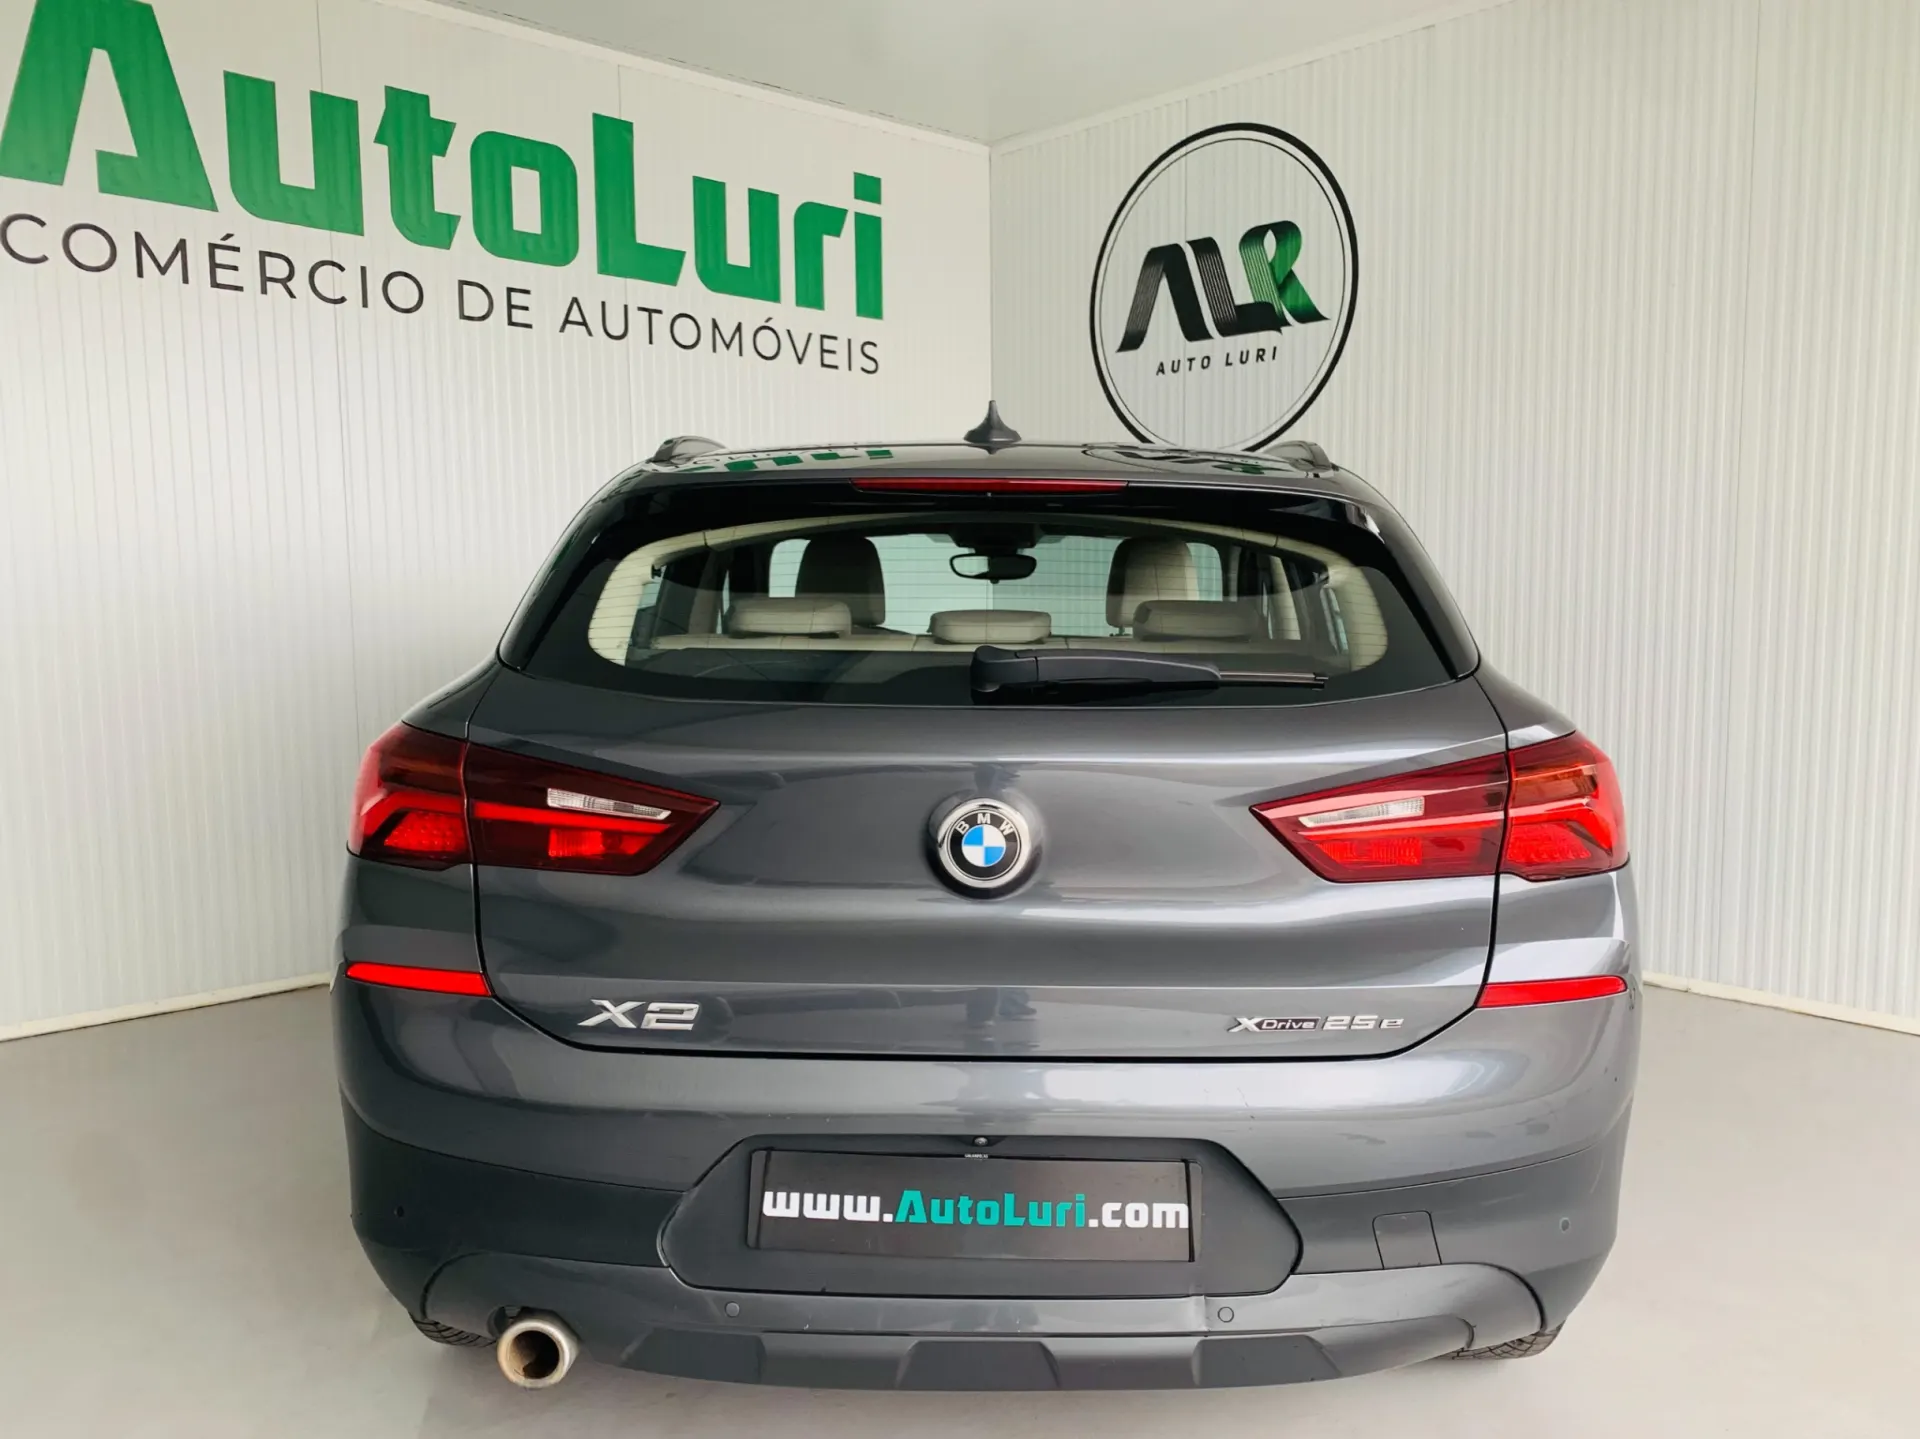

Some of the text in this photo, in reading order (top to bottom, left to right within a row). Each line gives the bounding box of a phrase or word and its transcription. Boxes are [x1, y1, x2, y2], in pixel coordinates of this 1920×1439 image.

[0, 0, 884, 320] AutoLuri
[1, 212, 881, 375] COMÉRCIO DE AUTOMÓVEIS
[1156, 346, 1278, 376] AUTO LURI
[955, 813, 1015, 836] BMW
[577, 999, 700, 1031] X2
[761, 1189, 1189, 1229] www.AutoLuri.com
